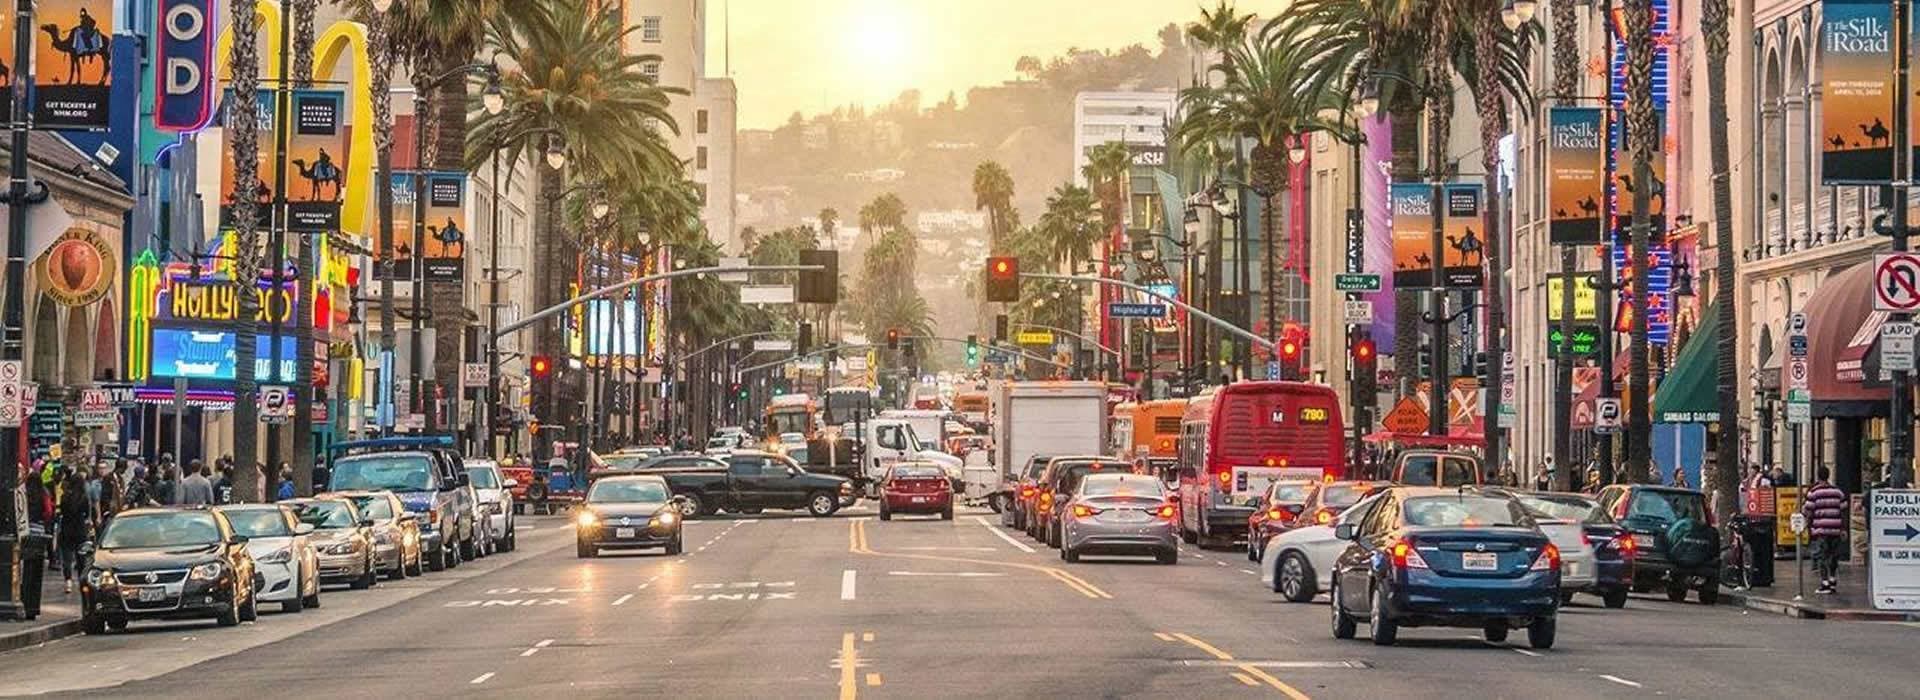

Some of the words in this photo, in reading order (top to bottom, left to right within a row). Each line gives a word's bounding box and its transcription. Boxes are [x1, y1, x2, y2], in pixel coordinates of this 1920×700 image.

[1848, 17, 1883, 37] Silk
[1834, 30, 1888, 52] Road
[1569, 122, 1594, 137] Silk
[1559, 132, 1598, 148] Road
[1407, 195, 1427, 206] Silk
[1399, 202, 1431, 215] Road
[1112, 304, 1148, 314] Highland
[1883, 325, 1912, 335] LAPD
[84, 391, 108, 403] ATM
[105, 388, 135, 402] ATM
[76, 412, 113, 420] INTERNET
[1303, 408, 1324, 420] 780
[222, 490, 230, 502] 5
[1874, 506, 1920, 516] PARKIN
[1879, 550, 1894, 559] PARK
[1895, 550, 1909, 559] LOCK
